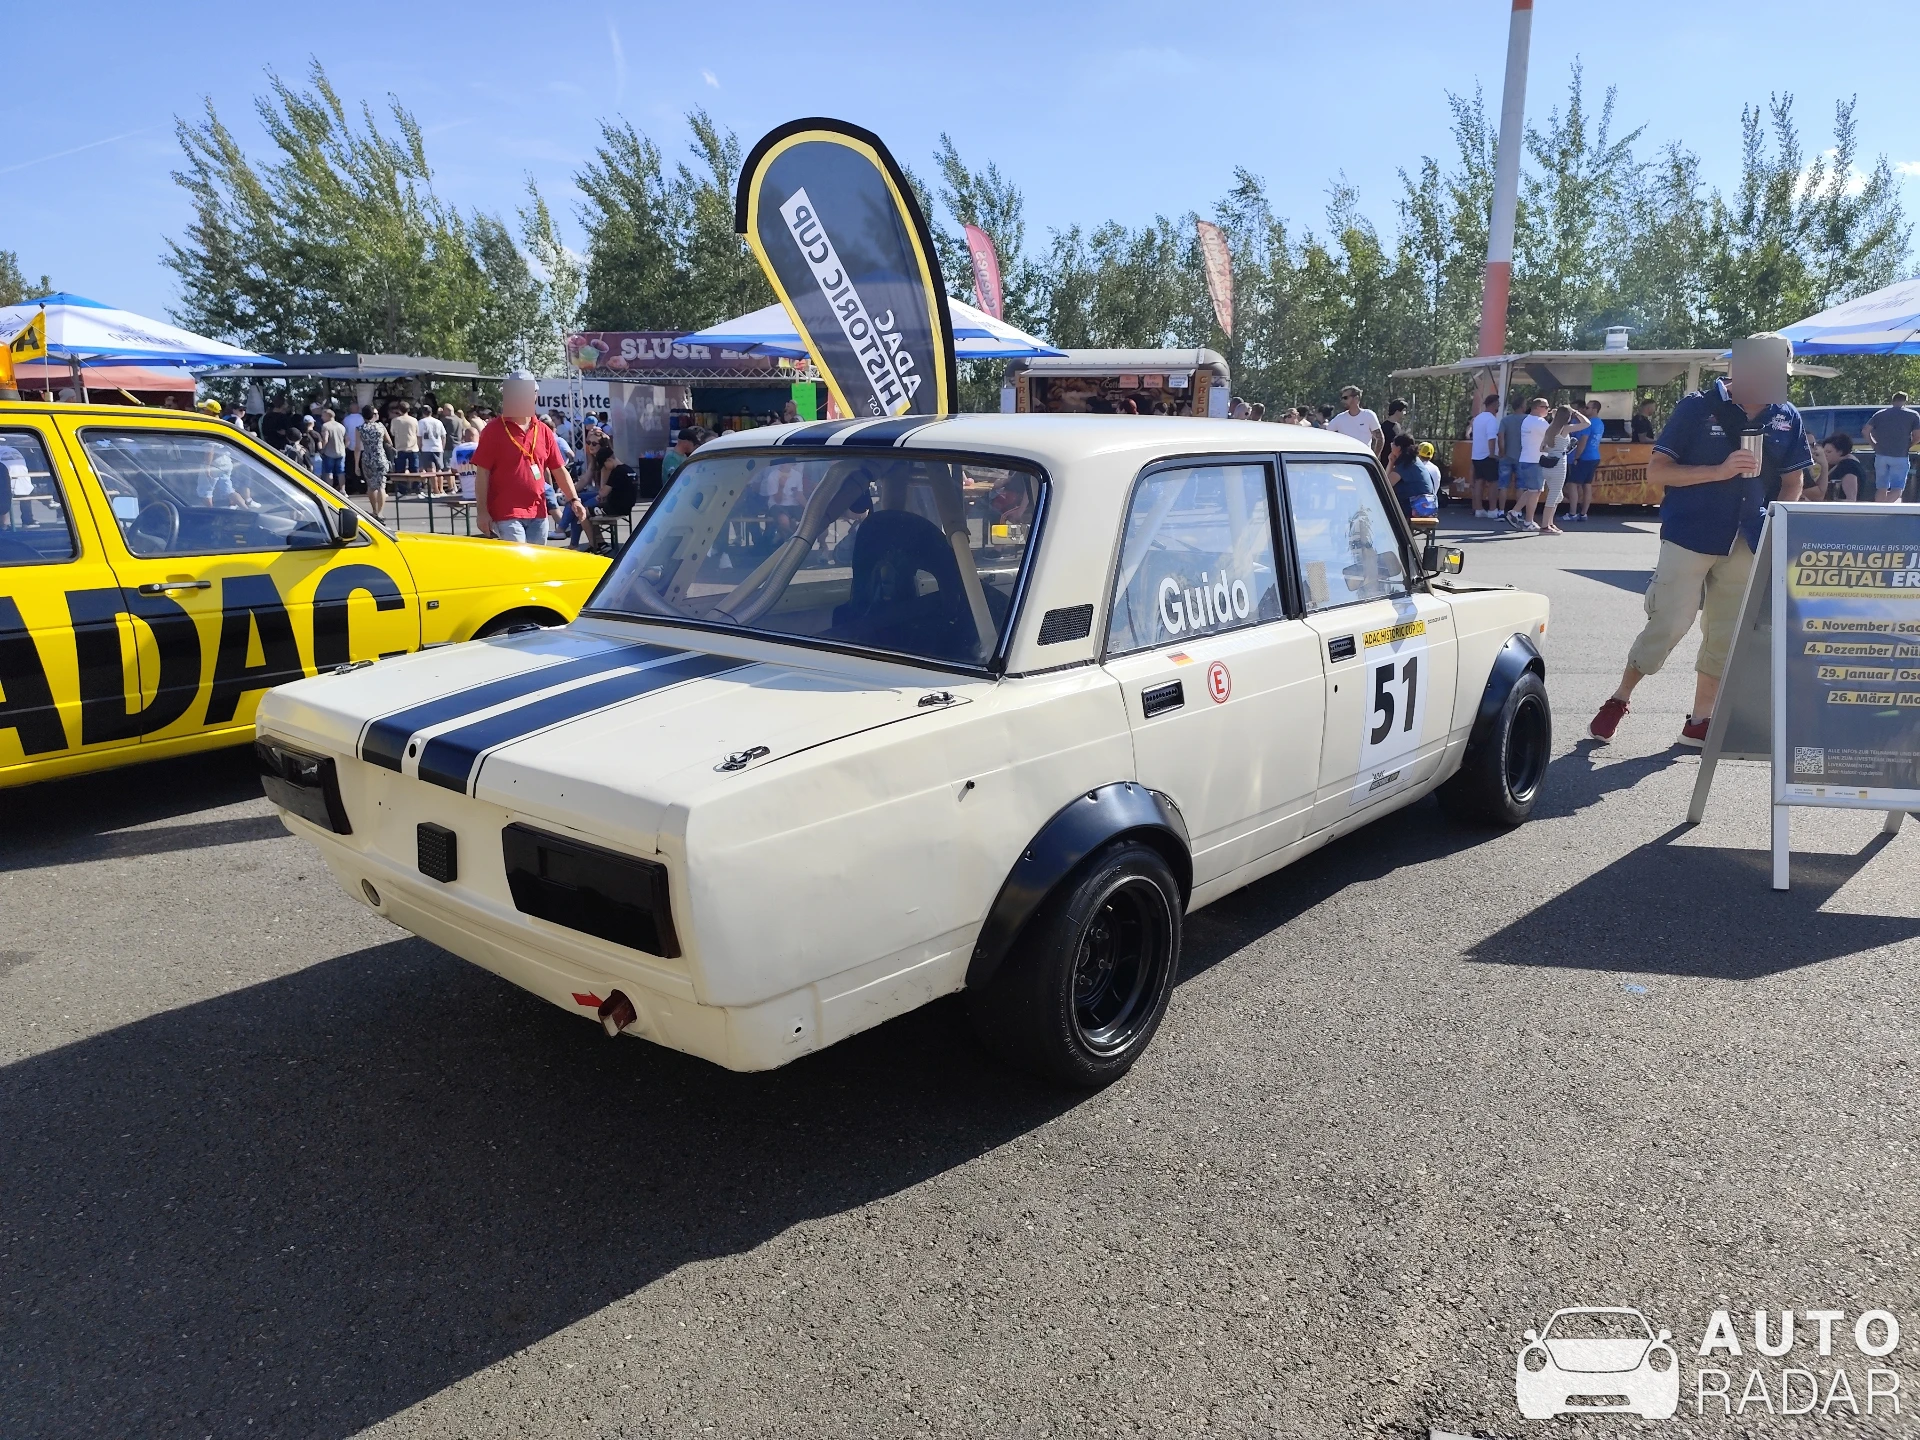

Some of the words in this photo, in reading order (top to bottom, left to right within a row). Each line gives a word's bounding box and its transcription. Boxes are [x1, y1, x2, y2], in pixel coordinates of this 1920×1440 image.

[620, 338, 711, 360] SLUSH
[1625, 468, 1648, 481] GRIL
[1802, 543, 1885, 551] RENNSPORT-ORIGINALE
[1800, 551, 1905, 568] OSTALGIE
[1906, 553, 1920, 569] J
[1800, 570, 1886, 586] DIGITAL
[1892, 572, 1920, 587] ER
[1158, 569, 1250, 635] Guido
[1806, 620, 1818, 630] 6.
[1822, 621, 1889, 631] November
[1364, 633, 1380, 645] ADAC
[1381, 626, 1405, 640] HISTORIC
[1405, 625, 1415, 635] CUP
[1808, 644, 1821, 653] 4.
[1825, 645, 1889, 656] Dezember
[1899, 646, 1920, 656] Nü
[0, 564, 406, 755] ADAC
[1214, 670, 1225, 694] E
[1821, 668, 1840, 678] 29.
[1844, 669, 1890, 680] Januar
[1370, 656, 1417, 745] 51
[1831, 693, 1851, 702] 26.
[1856, 693, 1890, 704] März
